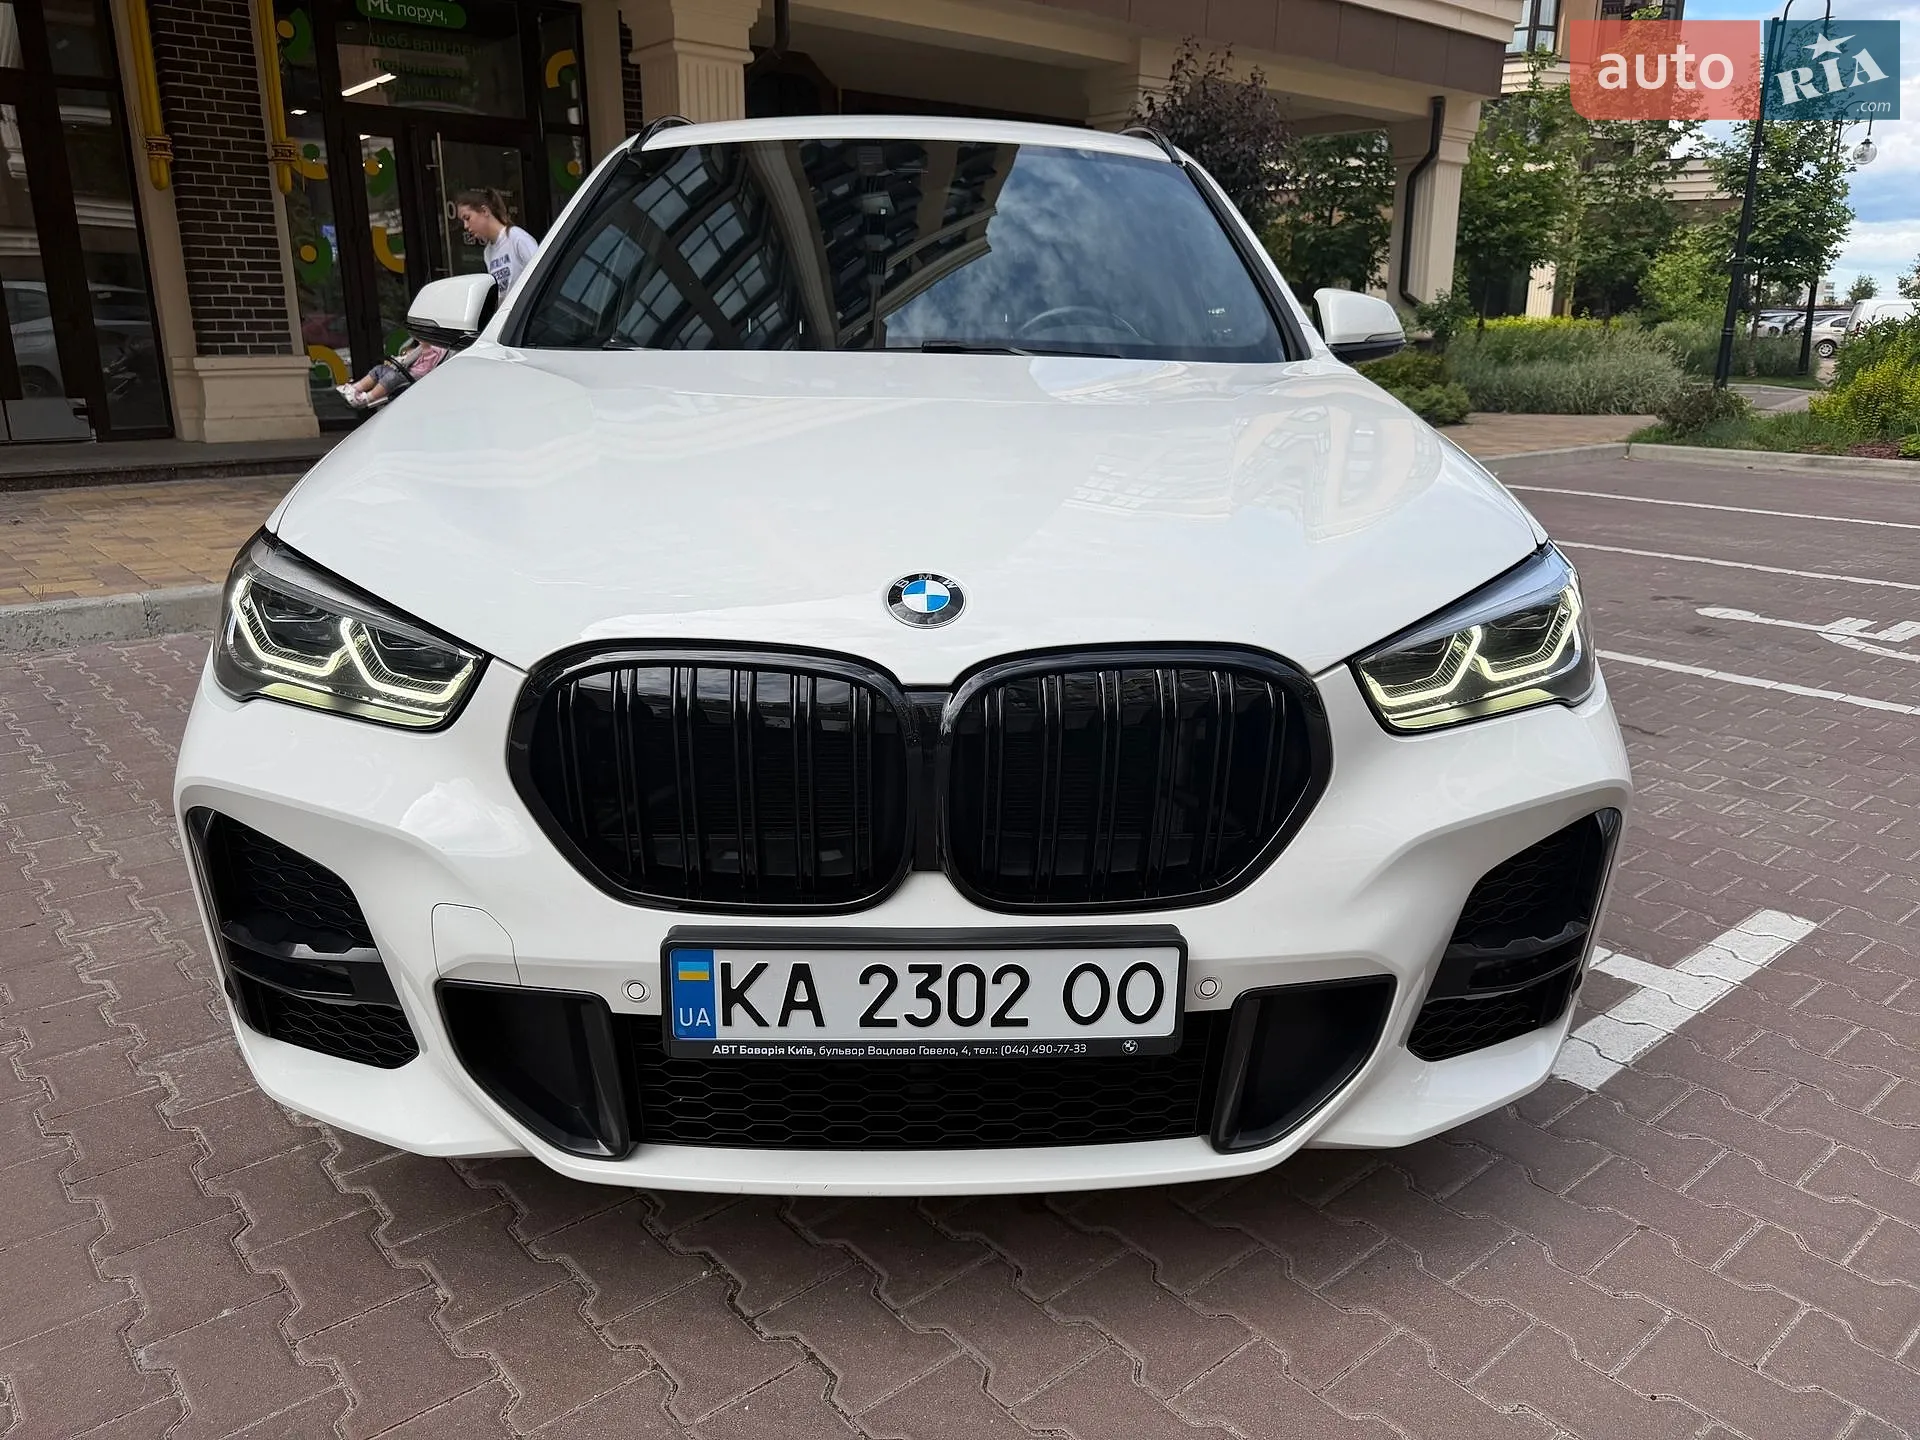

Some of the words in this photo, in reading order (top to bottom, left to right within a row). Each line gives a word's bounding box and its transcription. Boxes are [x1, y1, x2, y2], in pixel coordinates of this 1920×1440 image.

[397, 3, 448, 24] поруч,
[895, 574, 958, 589] BMW
[720, 962, 825, 1027] KA
[858, 963, 1030, 1027] 2302
[1062, 961, 1165, 1026] OO
[679, 1007, 711, 1027] UA
[712, 1045, 737, 1055] АВТ
[739, 1045, 785, 1056] Баварія
[787, 1044, 816, 1057] Київ,
[819, 1045, 864, 1056] бульвар
[867, 1046, 916, 1057] Вацлава
[919, 1045, 958, 1057] Гавела,
[961, 1045, 972, 1057] 4,
[974, 1046, 998, 1055] тел.:
[1001, 1044, 1029, 1056] (044)
[1032, 1043, 1087, 1055] 490-77-33
